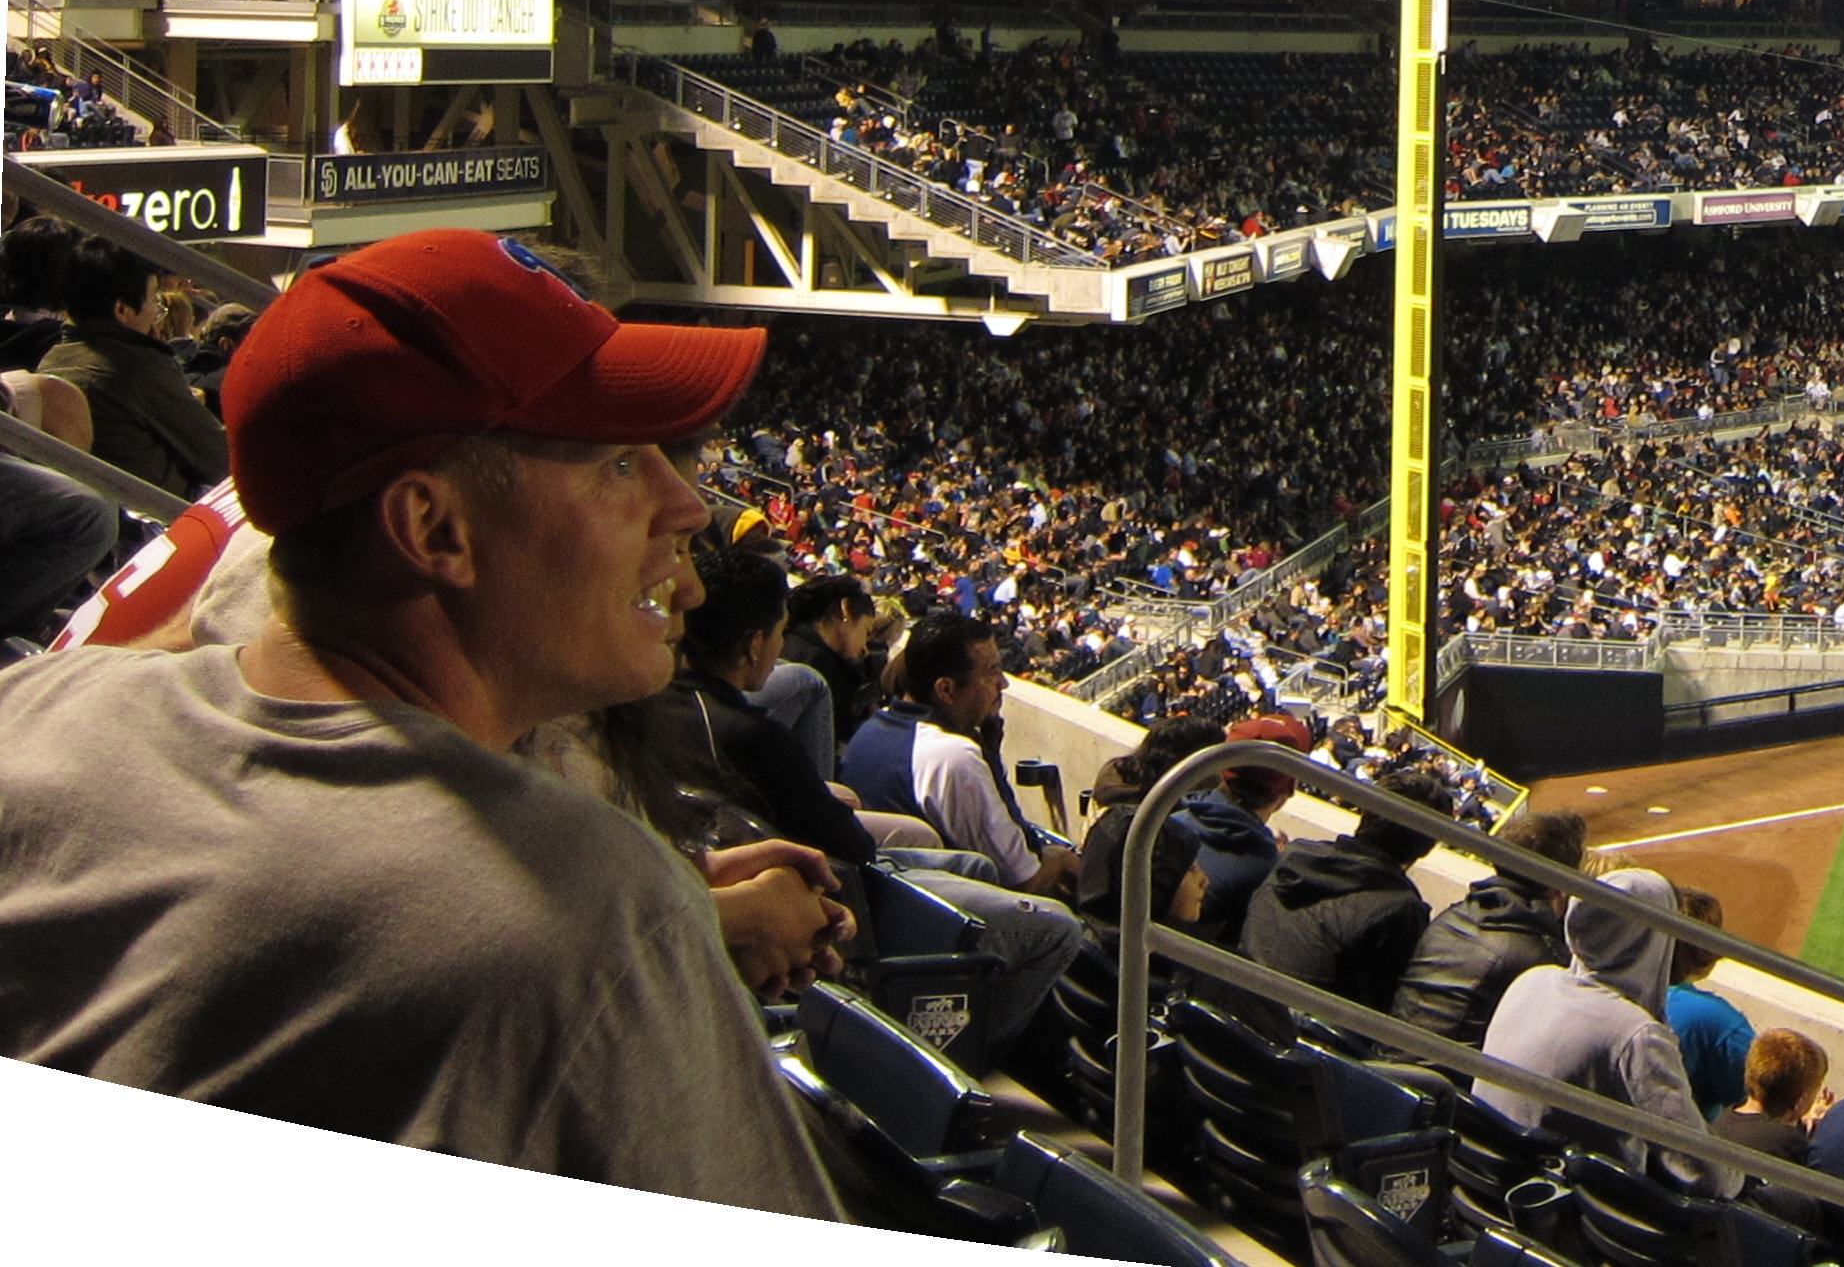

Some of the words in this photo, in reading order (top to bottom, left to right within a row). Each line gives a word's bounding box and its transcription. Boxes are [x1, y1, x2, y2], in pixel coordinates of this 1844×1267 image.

[344, 158, 495, 192] ALL-YOU-CAN-EAT
[496, 156, 540, 181] SEATS
[1703, 201, 1743, 216] ASHFORD
[1744, 198, 1794, 215] UNIVERSITY
[1452, 210, 1529, 230] TUESDAYS
